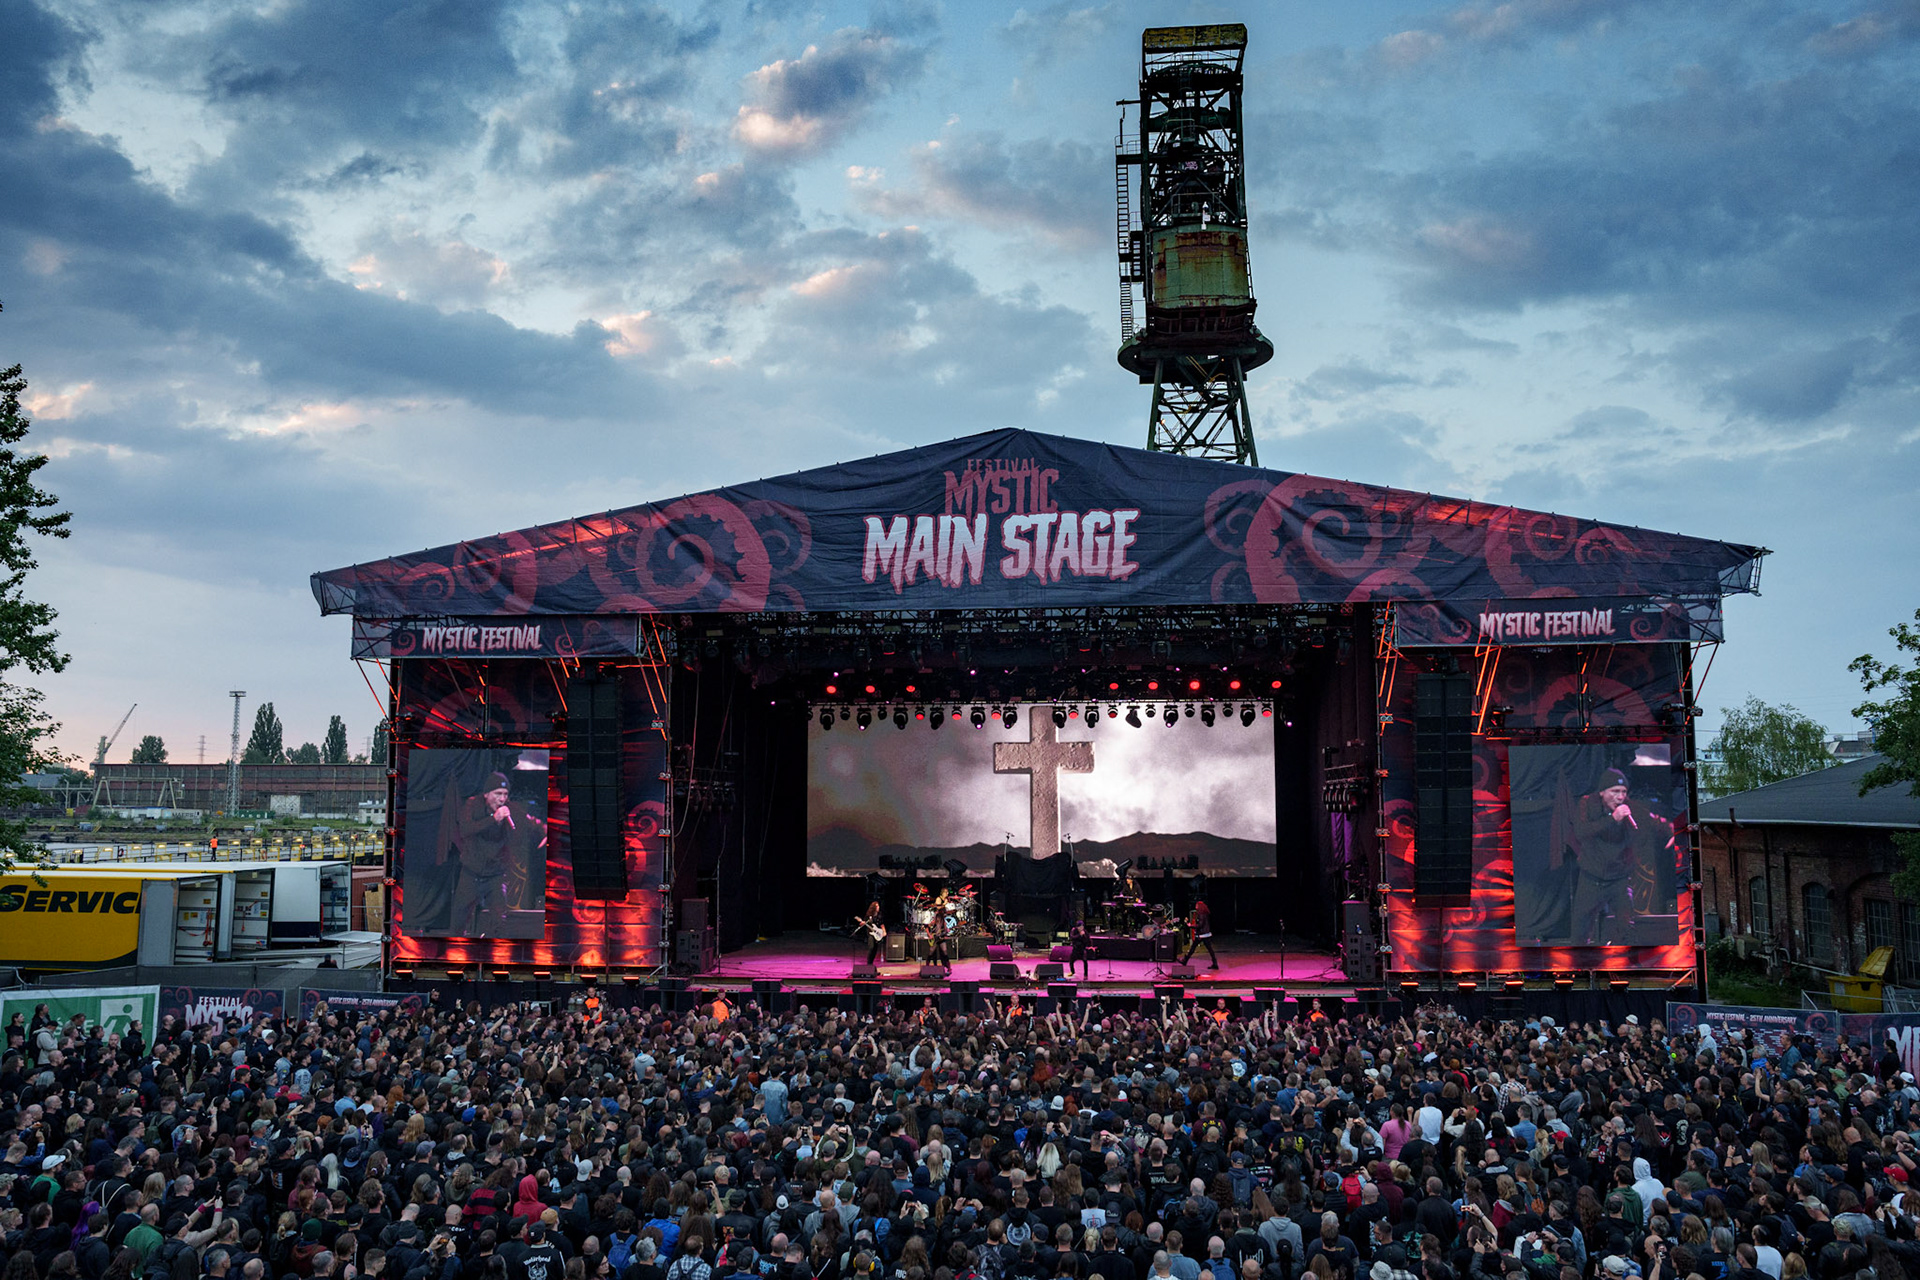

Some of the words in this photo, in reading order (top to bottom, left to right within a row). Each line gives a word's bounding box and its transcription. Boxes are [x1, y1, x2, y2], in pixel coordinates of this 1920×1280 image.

[967, 457, 1041, 473] FESTIVAL
[944, 468, 1059, 520] MYSTIC
[862, 512, 989, 594] MAIN
[1000, 507, 1140, 585] STAGE
[422, 625, 479, 654] MYSTIC
[480, 623, 544, 654] FESTIVAL
[1479, 611, 1541, 641] MYSTIC
[1544, 607, 1616, 640] FESTIVAL
[0, 884, 141, 914] SERVIC
[199, 996, 243, 1007] FESTIVAL
[1706, 1012, 1724, 1020] MYSTIC
